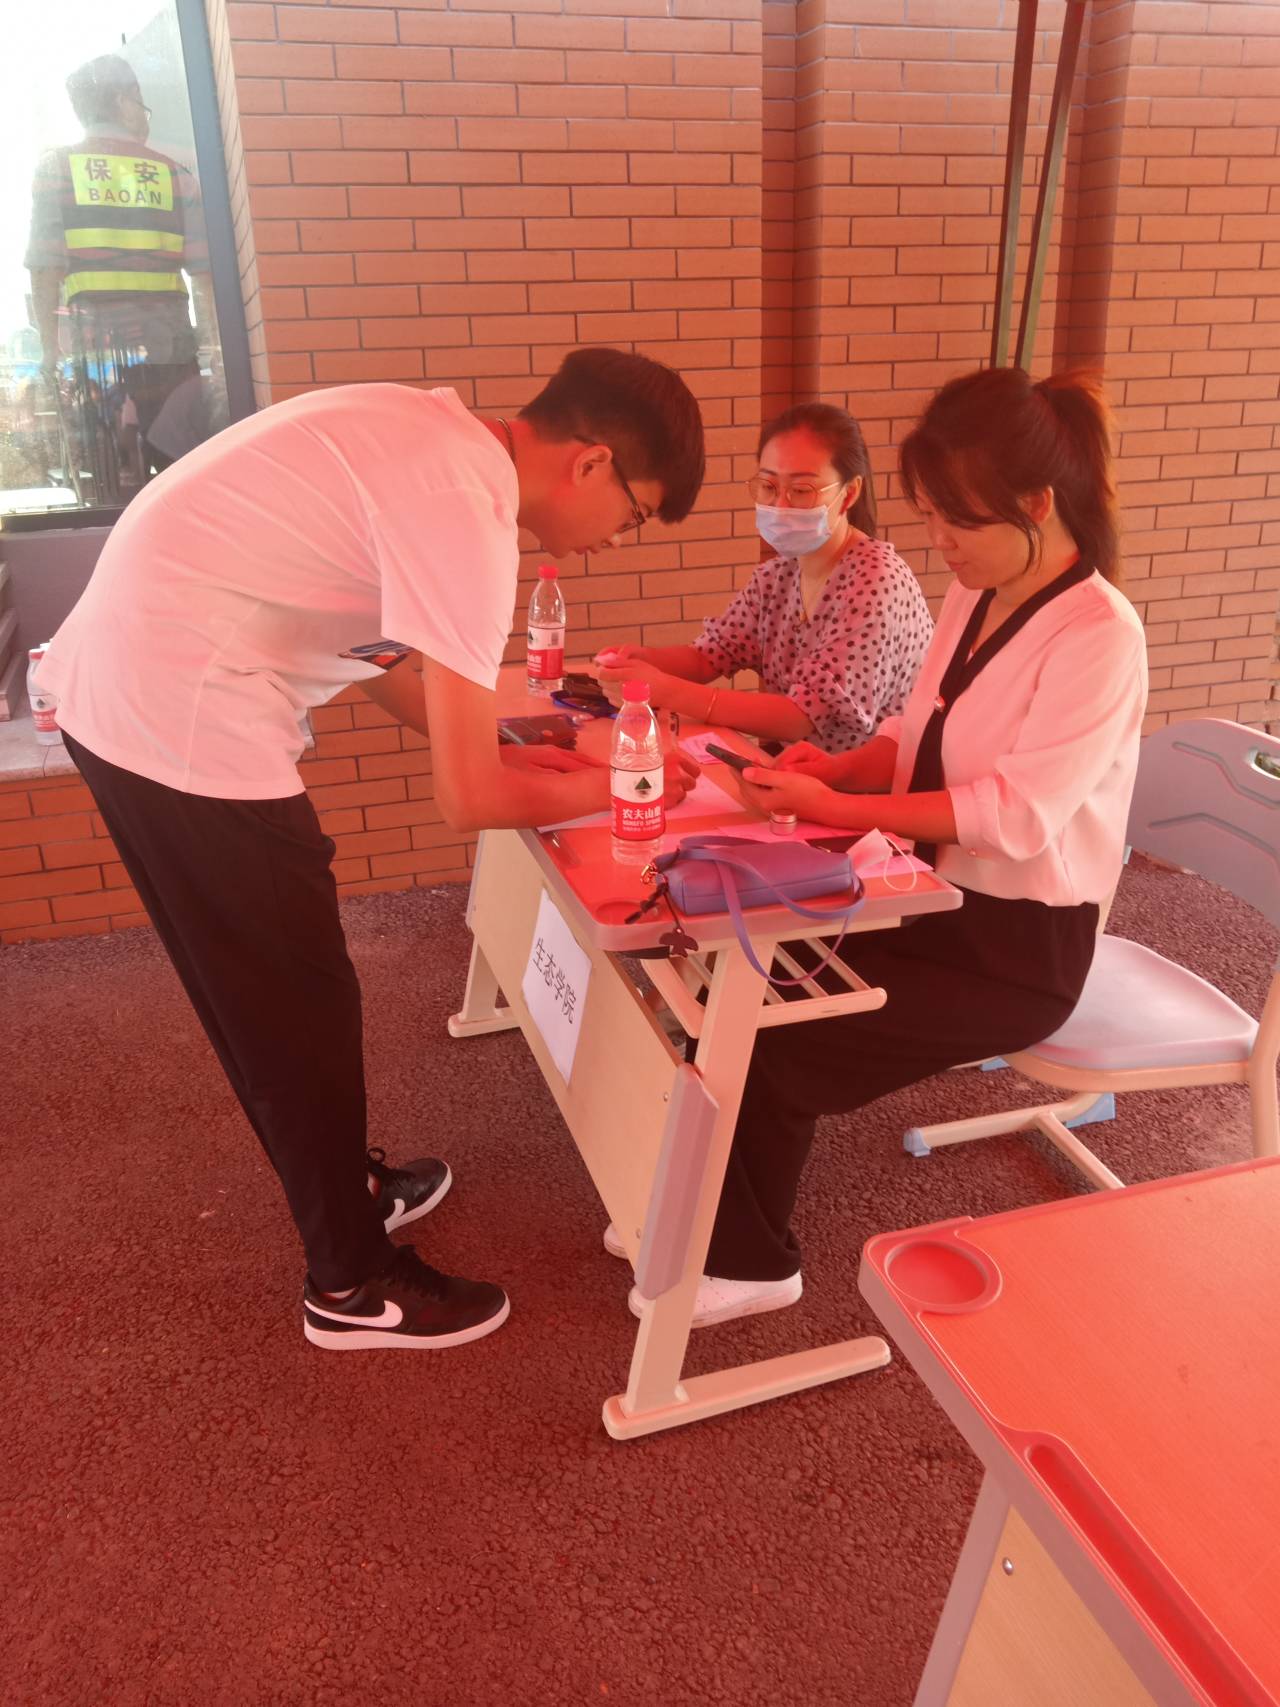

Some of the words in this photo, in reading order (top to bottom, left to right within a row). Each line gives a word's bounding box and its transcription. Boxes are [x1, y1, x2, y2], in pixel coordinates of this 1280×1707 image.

[85, 158, 160, 185] 保安
[88, 188, 162, 205] BAOAN
[532, 937, 577, 1025] 生态学院
